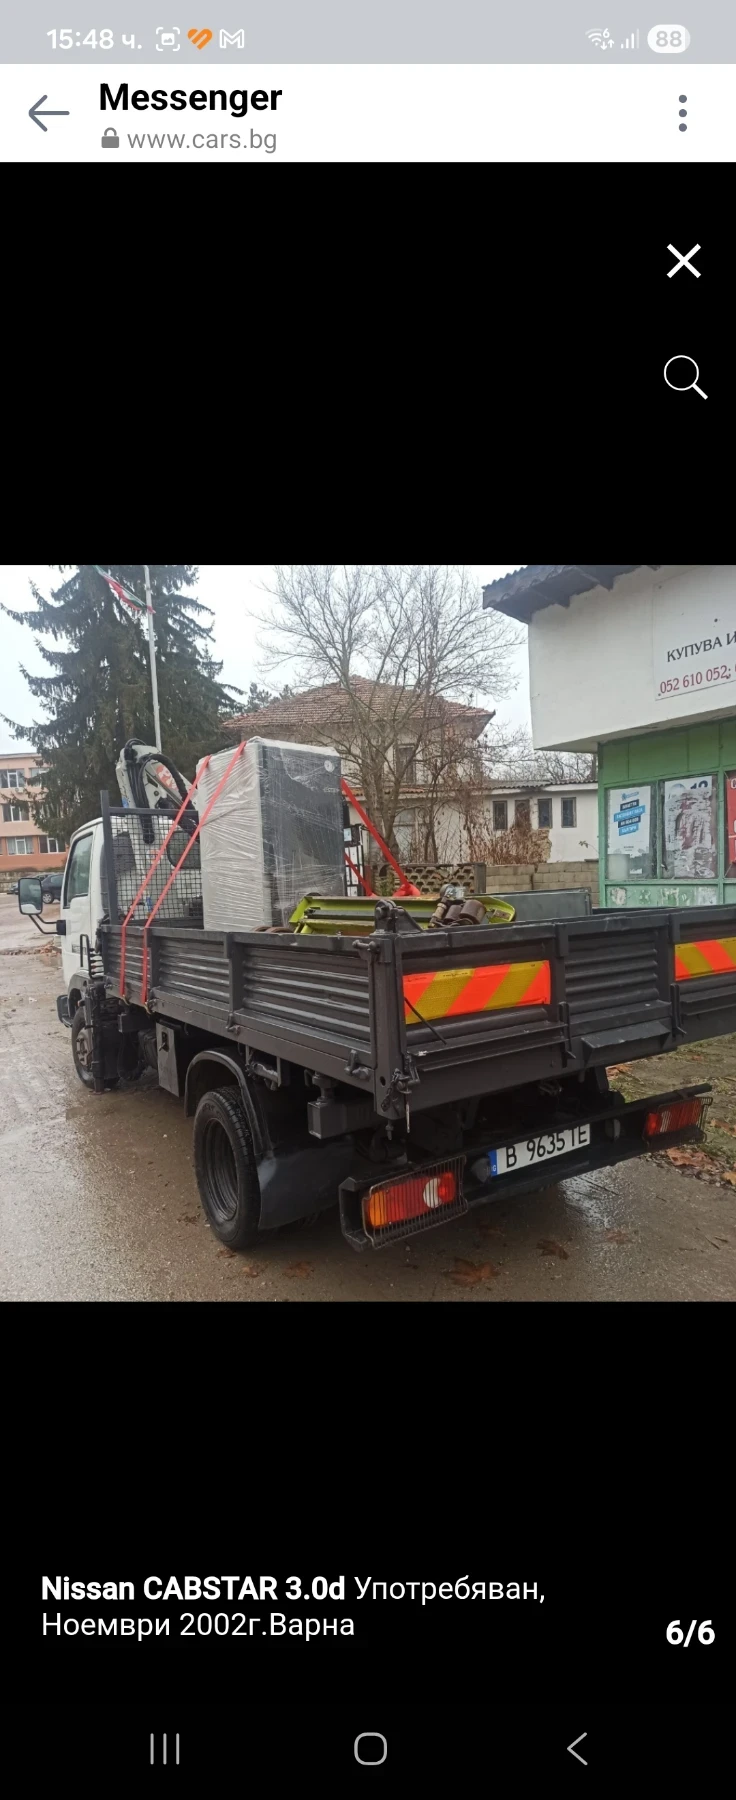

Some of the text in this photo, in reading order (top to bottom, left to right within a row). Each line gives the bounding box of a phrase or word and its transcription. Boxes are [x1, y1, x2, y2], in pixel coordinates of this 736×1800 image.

[666, 636, 723, 662] КУПУВА
[659, 677, 680, 694] 052
[682, 671, 703, 688] 610
[505, 1146, 517, 1169] B
[526, 1132, 565, 1161] 9635
